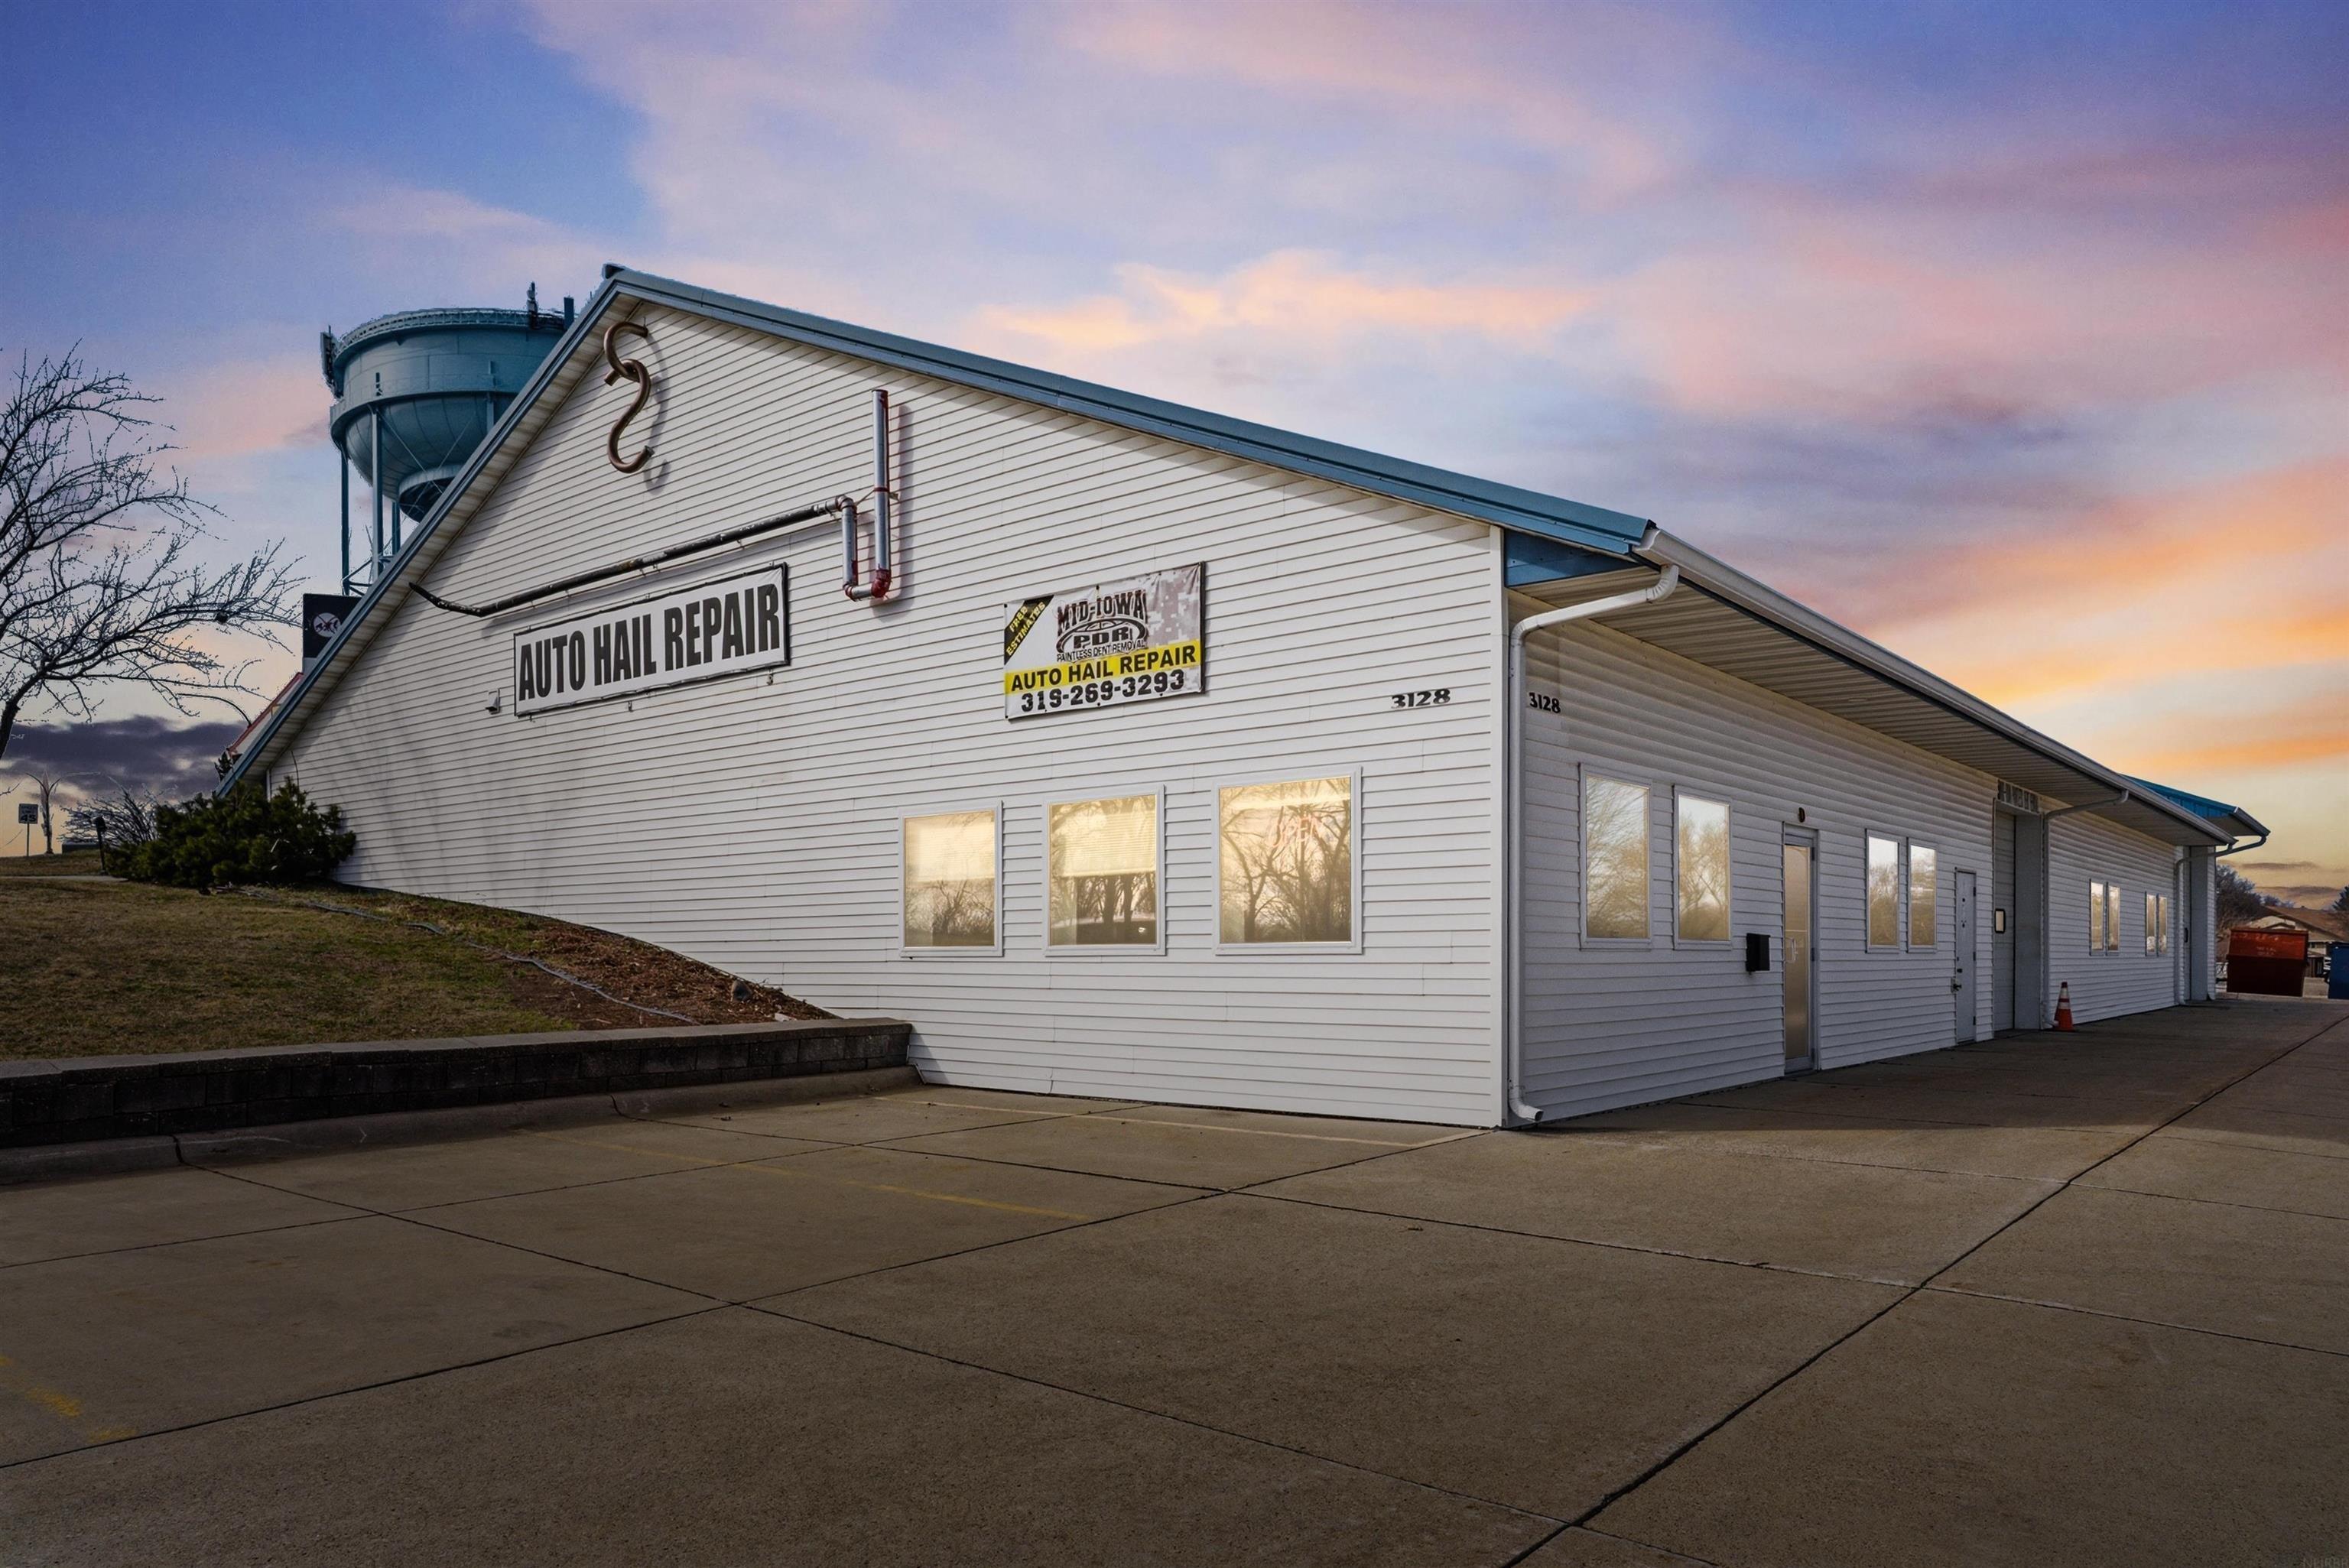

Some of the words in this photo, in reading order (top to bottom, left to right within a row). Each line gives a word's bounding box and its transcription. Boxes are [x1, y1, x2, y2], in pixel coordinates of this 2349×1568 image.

[1006, 602, 1046, 656] ESTIMATES
[1009, 605, 1028, 632] FREE
[1057, 589, 1146, 637] MID-IOWA
[518, 629, 586, 703] AUTO
[593, 613, 657, 687] HAIL
[664, 583, 781, 672] REPAIR
[1057, 647, 1092, 662] PAINTLESS
[1093, 644, 1111, 657] DENT
[1112, 639, 1145, 654] REMOVAL
[1073, 626, 1132, 649] PDR
[1011, 667, 1062, 692] AUTO
[1068, 660, 1113, 683] HAIL
[1119, 645, 1196, 674] REPAIR
[1021, 668, 1184, 713] 319-269-3293
[1391, 688, 1451, 709] 3128
[1529, 692, 1561, 714] 3128
[1268, 813, 1321, 849] OPEN
